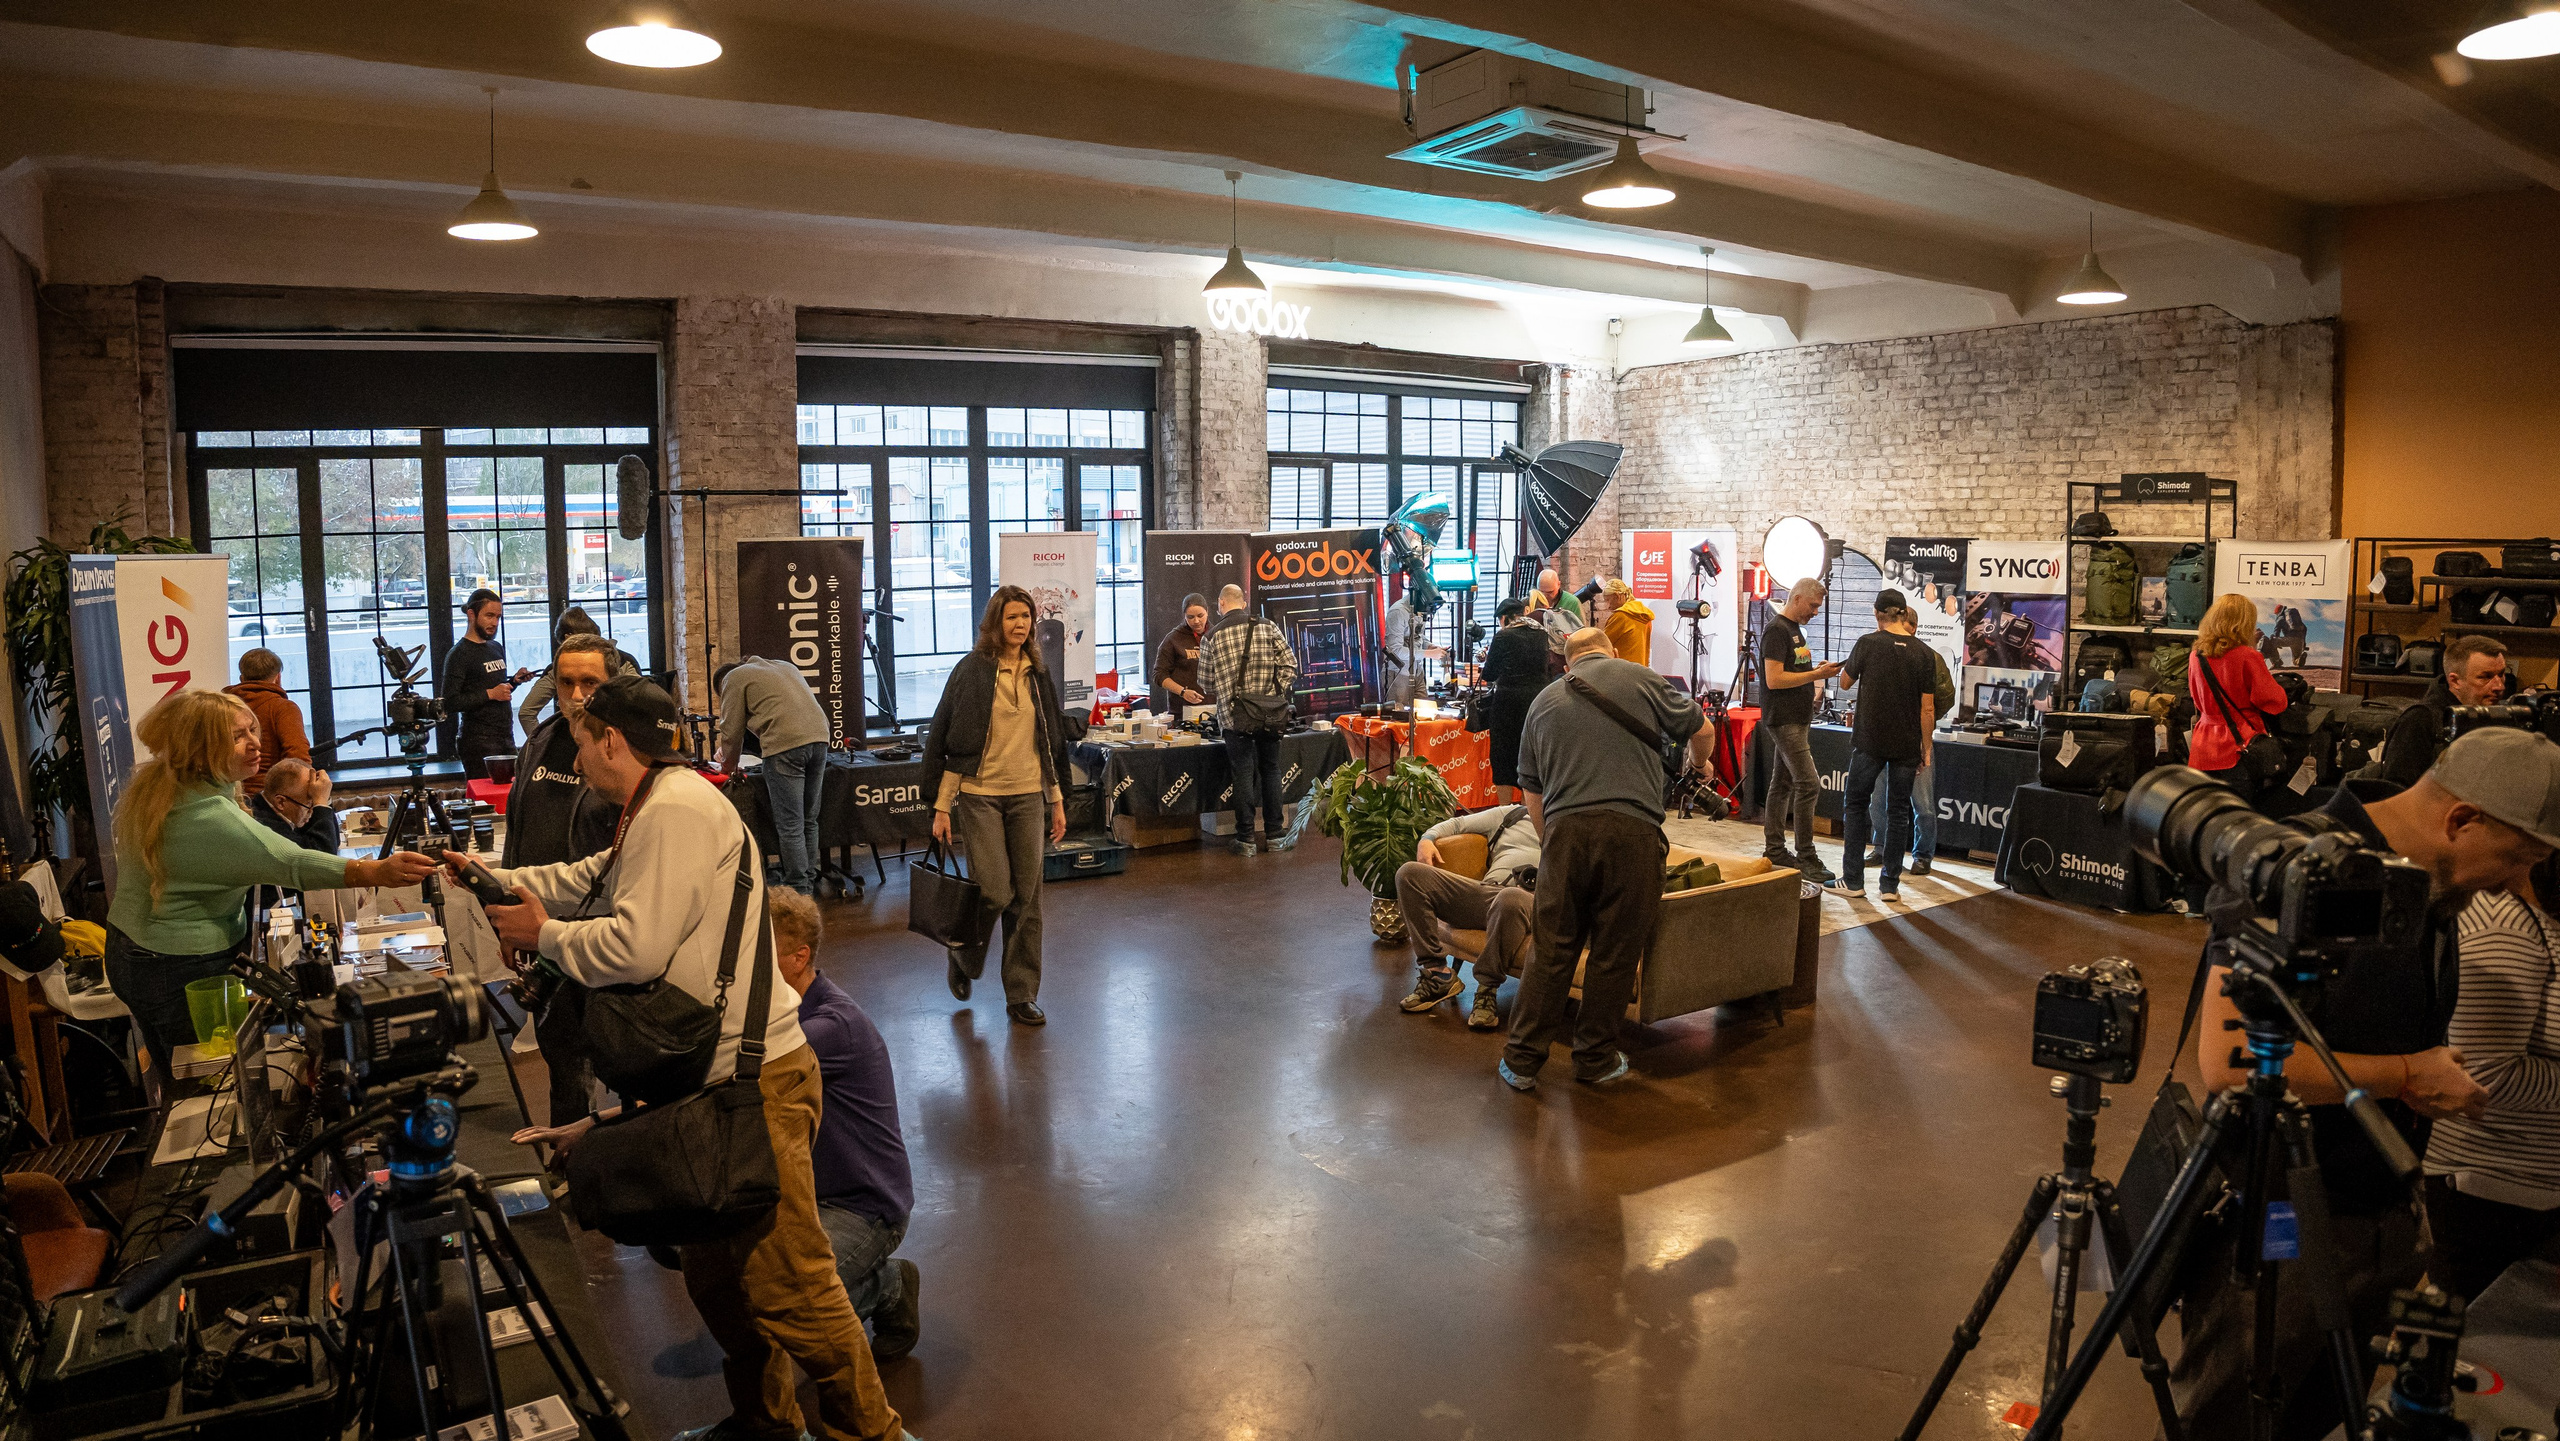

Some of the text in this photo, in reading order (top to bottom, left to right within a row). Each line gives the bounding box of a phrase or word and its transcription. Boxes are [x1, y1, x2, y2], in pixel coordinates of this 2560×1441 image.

[2157, 481, 2190, 490] Shimoda
[1276, 541, 1318, 553] godox.ru
[1909, 543, 1957, 562] SmallRig
[1033, 553, 1065, 561] RICOH
[1213, 553, 1234, 565] GR
[1256, 540, 1375, 581] Godox
[1979, 557, 2051, 579] SYNCO
[2247, 561, 2317, 577] TENBA
[1258, 583, 1290, 591] Professional
[1336, 578, 1354, 586] lighting
[1429, 726, 1462, 747] Godox
[1161, 771, 1190, 804] RICOH
[613, 815, 630, 851] Canon
[2060, 852, 2126, 881] Shimoda
[2059, 870, 2100, 884] EXPLORE
